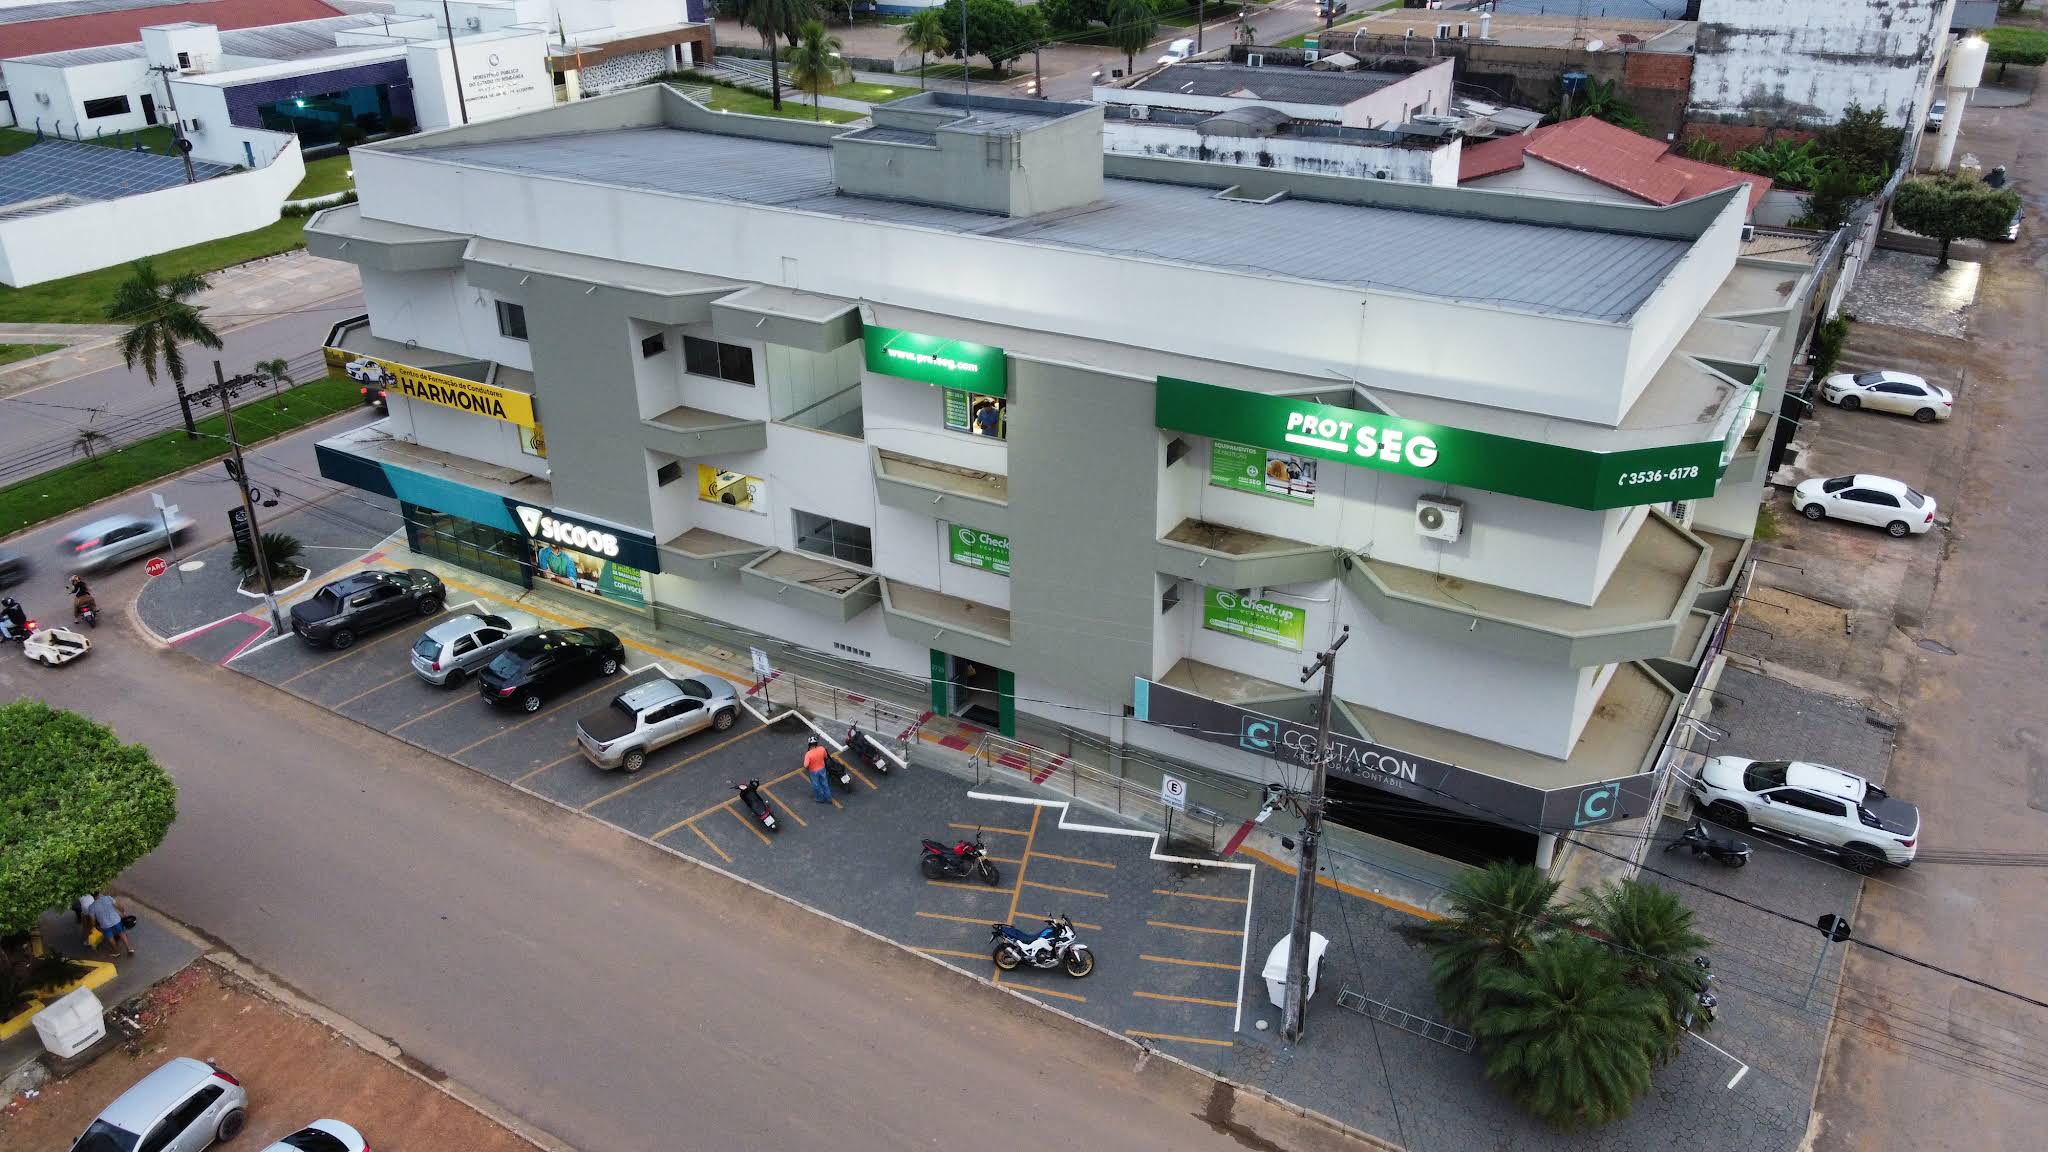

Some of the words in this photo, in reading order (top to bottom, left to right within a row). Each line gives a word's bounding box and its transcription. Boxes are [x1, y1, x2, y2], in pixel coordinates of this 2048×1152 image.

[399, 367, 420, 379] Centro
[419, 372, 428, 381] de
[428, 374, 458, 388] Formação
[459, 381, 467, 390] de
[467, 383, 503, 398] Condutores
[401, 377, 507, 419] HARMONIA
[1286, 411, 1353, 441] PROT
[1354, 425, 1438, 468] SEG
[1628, 465, 1699, 485] 3536-6178
[540, 516, 620, 557] SICOOB
[979, 533, 1010, 549] Check
[146, 561, 165, 573] PARE
[1240, 596, 1277, 615] Check
[1278, 609, 1294, 621] up
[1171, 782, 1178, 793] E
